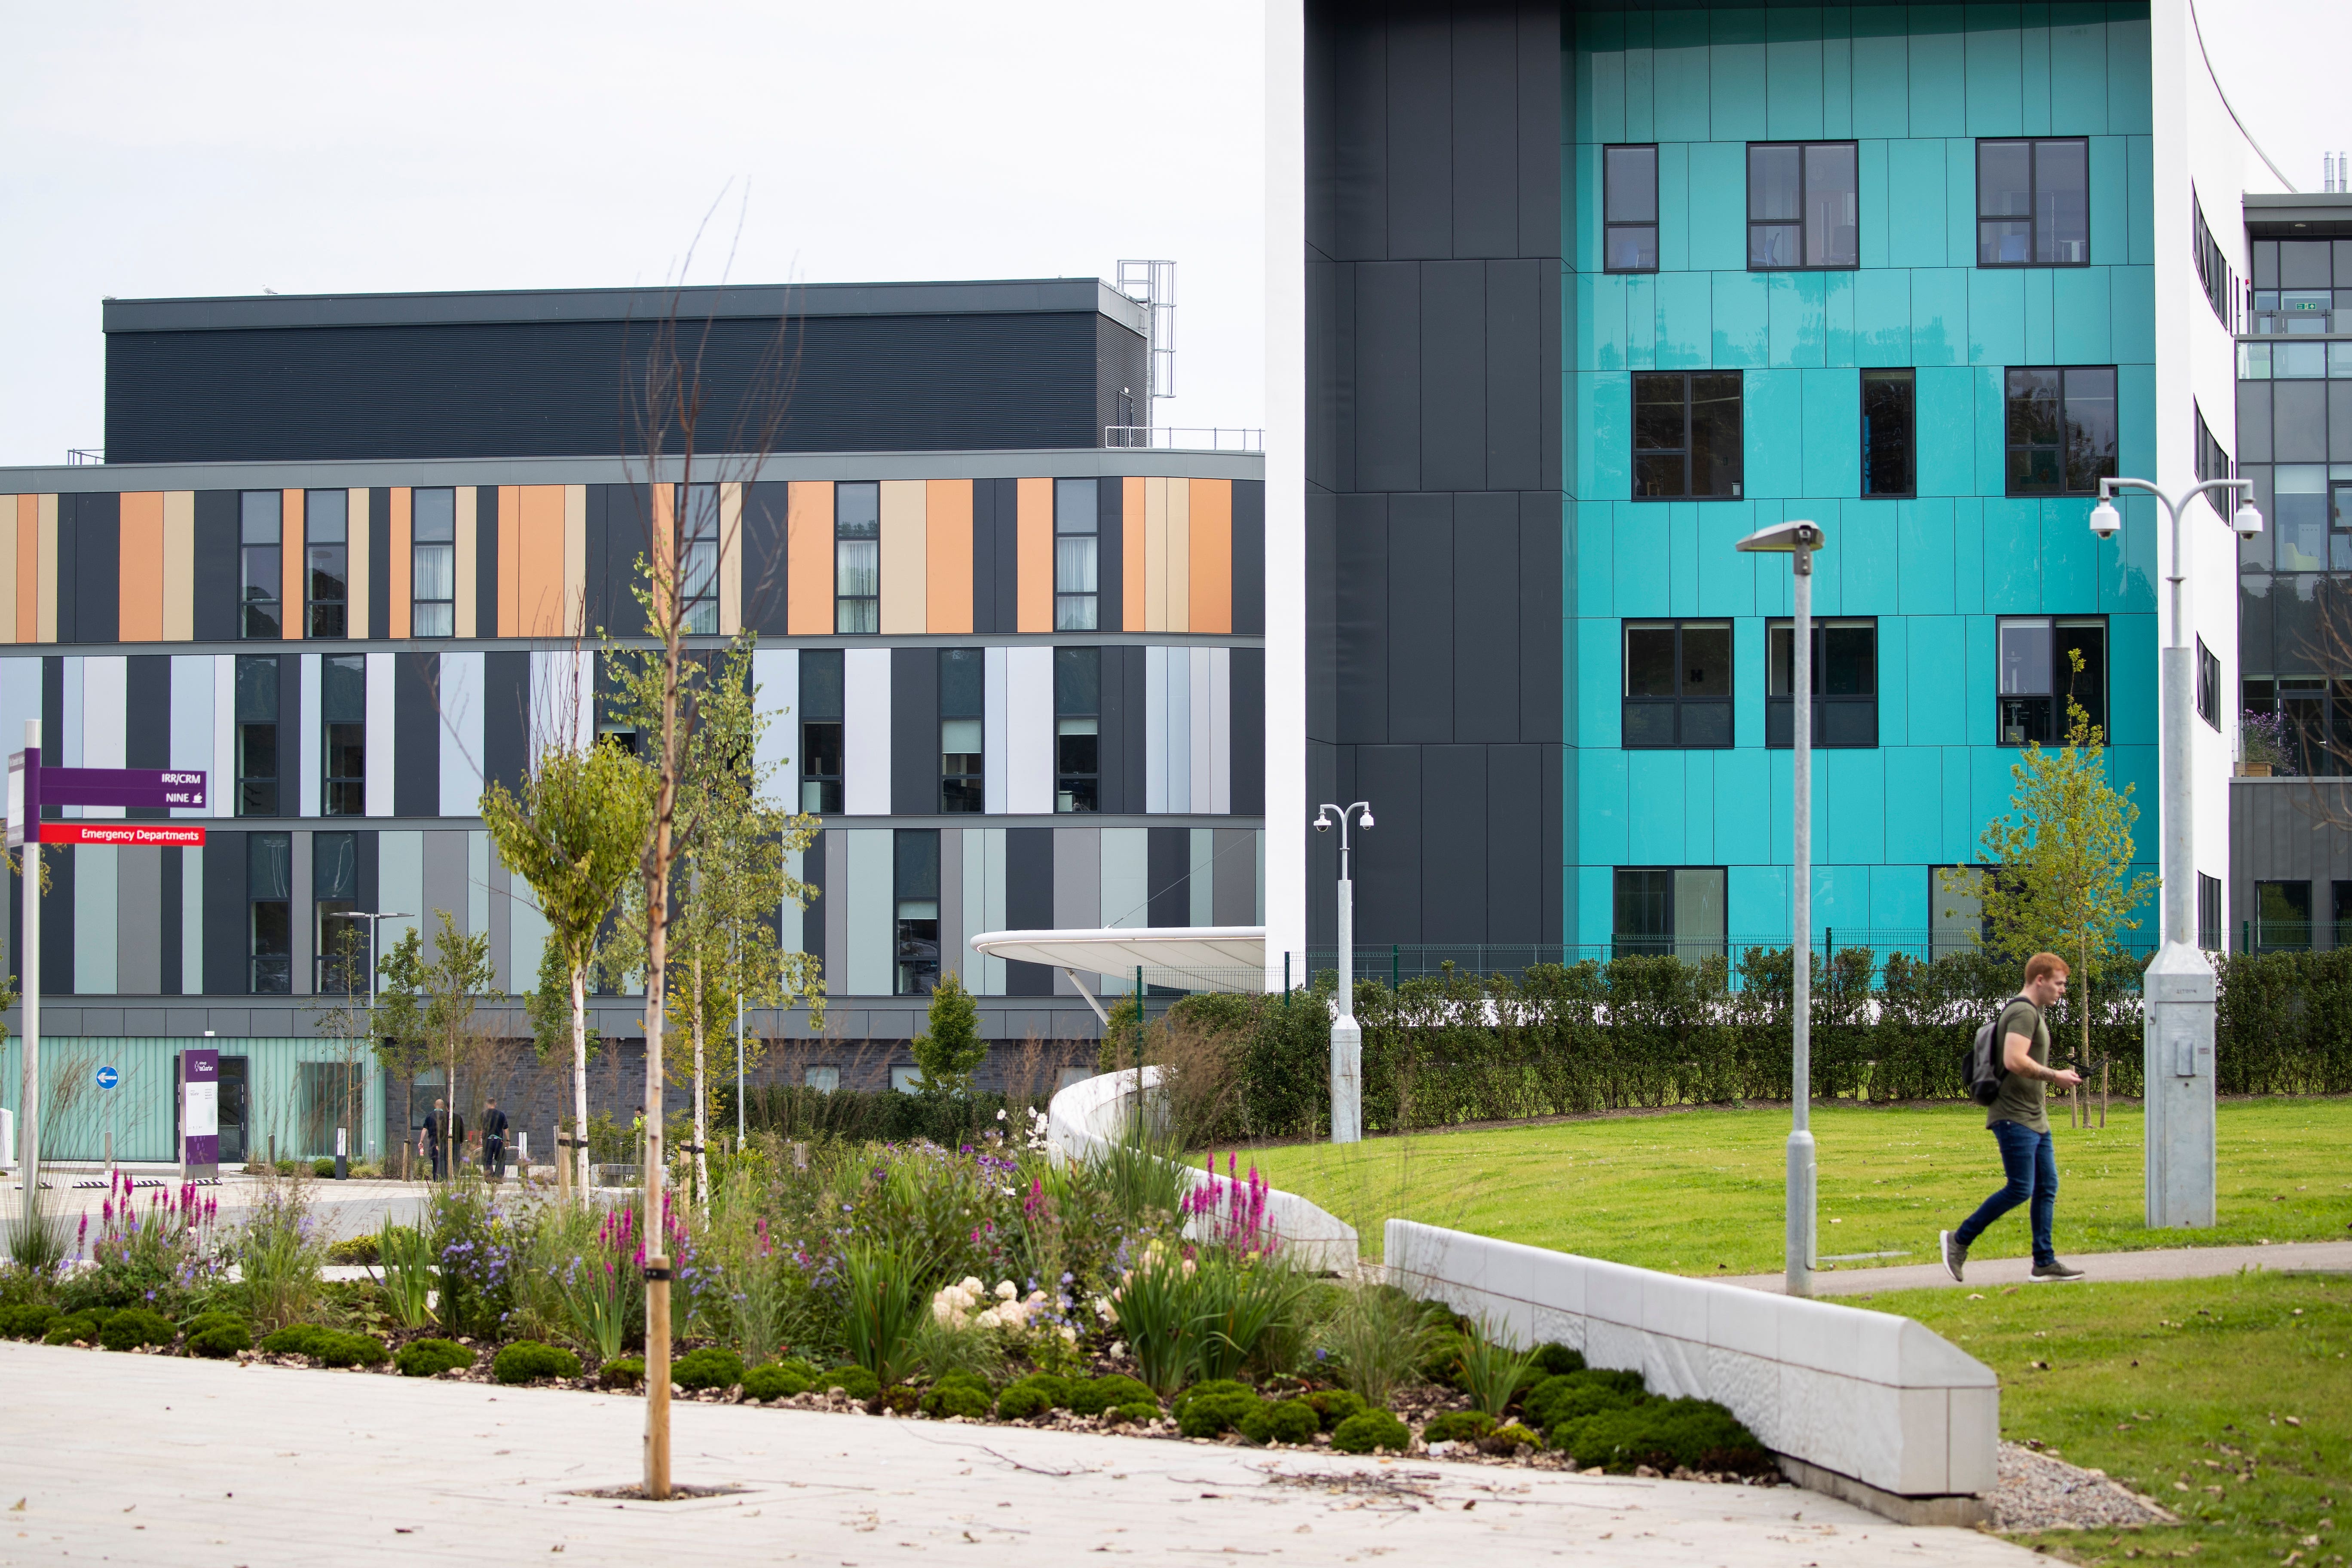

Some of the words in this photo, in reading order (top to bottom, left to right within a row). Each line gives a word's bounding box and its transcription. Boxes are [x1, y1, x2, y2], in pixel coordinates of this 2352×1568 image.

[162, 773, 201, 786] IRR/CRM
[166, 793, 190, 802] NINE
[82, 829, 135, 841] Emergency
[137, 830, 199, 842] Departments
